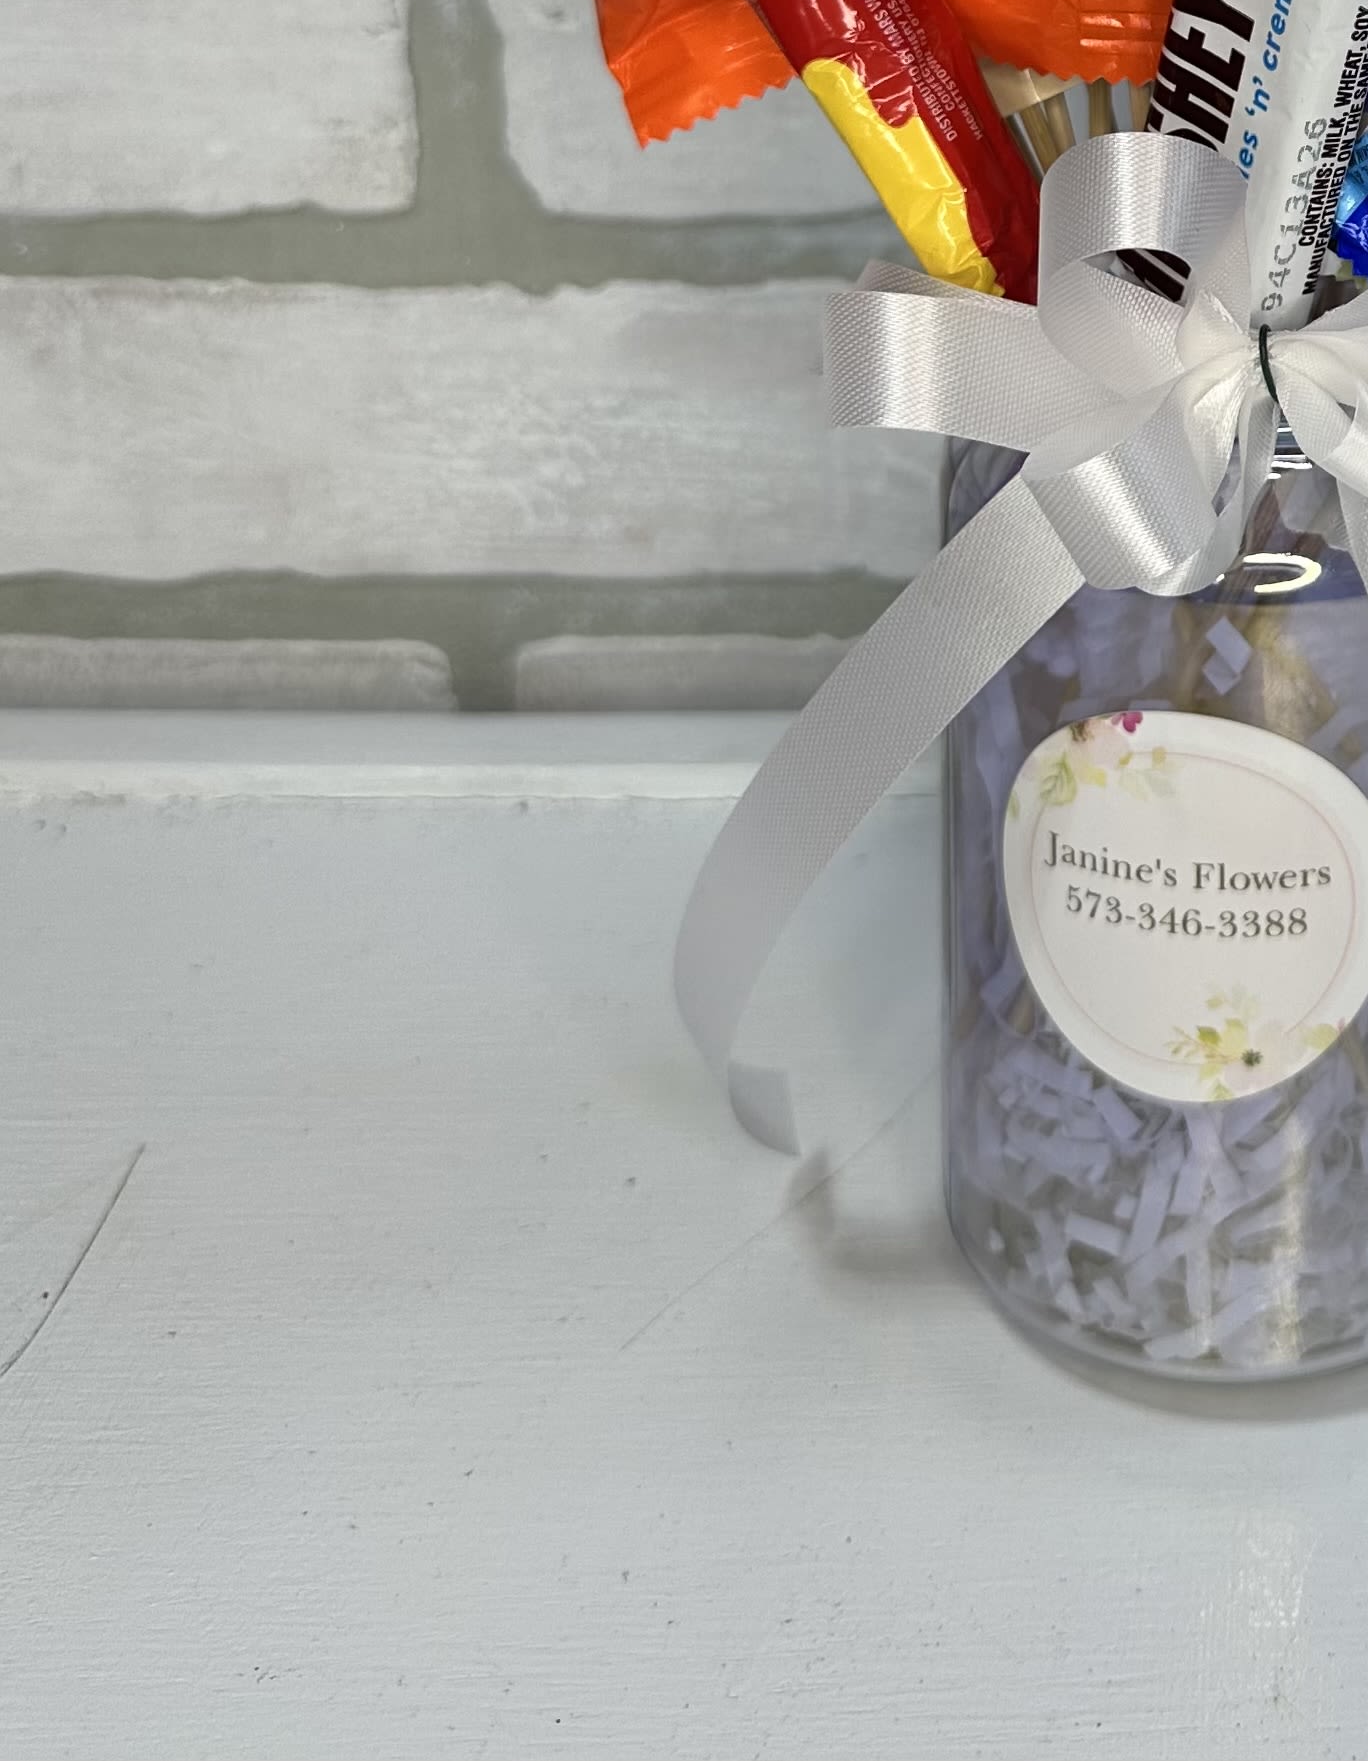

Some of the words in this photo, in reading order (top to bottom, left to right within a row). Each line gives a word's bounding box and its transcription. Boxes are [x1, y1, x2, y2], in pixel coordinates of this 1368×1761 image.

[872, 8, 904, 48] MARS
[895, 46, 915, 67] BY
[906, 64, 959, 141] DISTRIBUTED
[1345, 102, 1364, 135] THE
[1299, 161, 1335, 248] CONTAINS:
[1321, 110, 1349, 160] MILK,
[1335, 43, 1366, 110] WHEAT,
[1338, 136, 1356, 162] ON
[1303, 165, 1348, 296] MANUFACTURED
[1043, 830, 1178, 888] Janine's
[1192, 861, 1332, 891] Flowers
[1065, 883, 1309, 940] 573-346-3388
